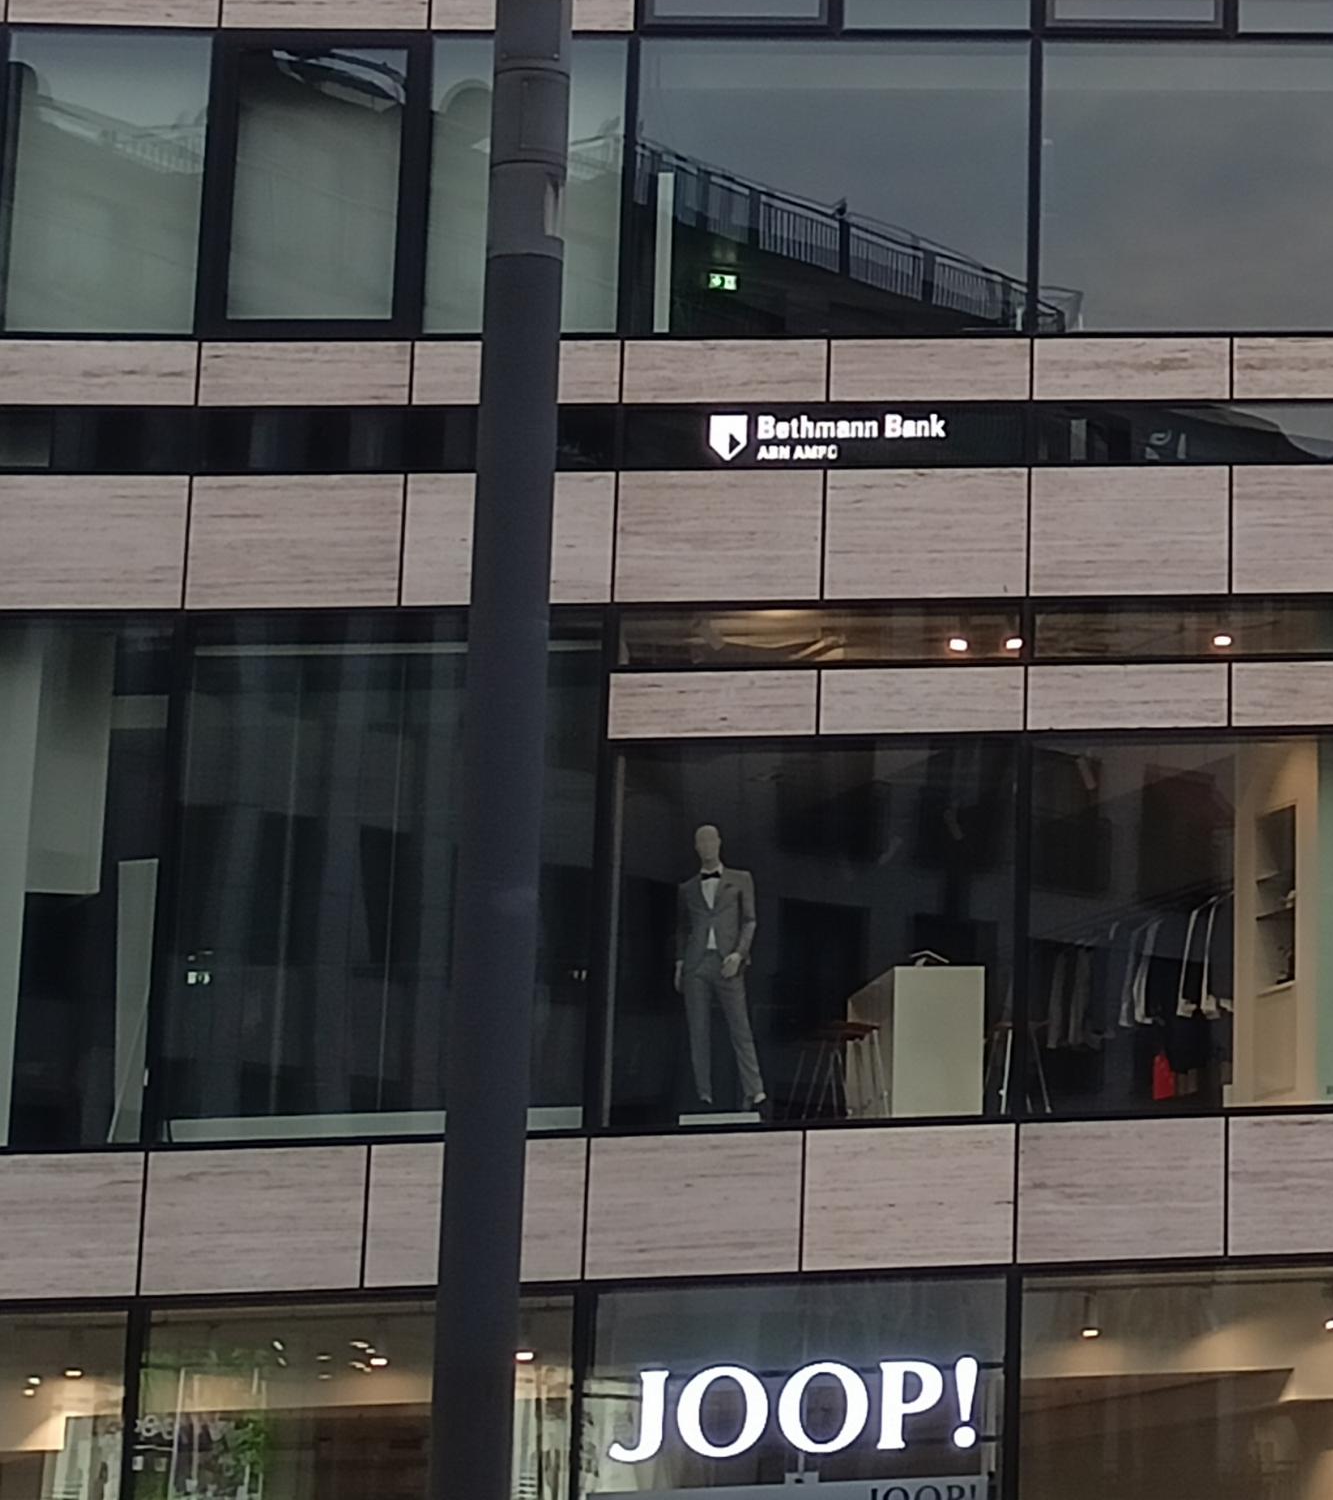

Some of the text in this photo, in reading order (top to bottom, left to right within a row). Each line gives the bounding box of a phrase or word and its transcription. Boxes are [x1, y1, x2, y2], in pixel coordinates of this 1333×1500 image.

[756, 413, 947, 440] Bethmann Bank
[608, 1355, 979, 1463] JOOP!
